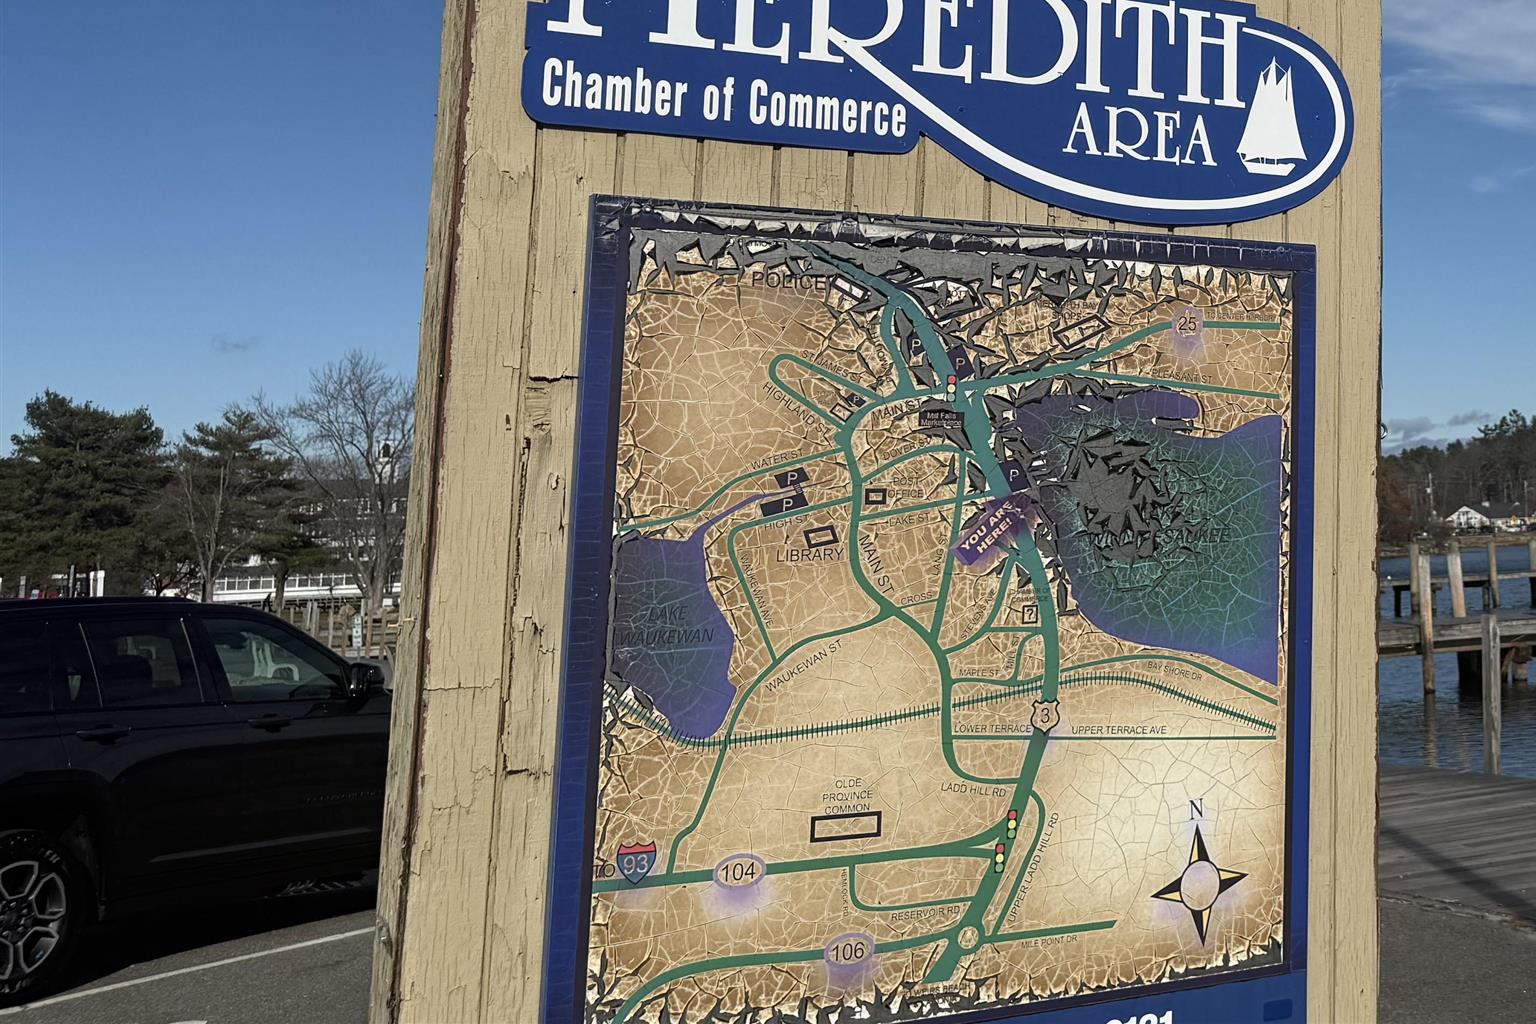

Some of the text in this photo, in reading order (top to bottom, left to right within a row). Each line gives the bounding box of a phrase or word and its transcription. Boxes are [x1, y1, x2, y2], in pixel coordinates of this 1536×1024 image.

[542, 56, 908, 139] Chamber of Commerce
[1062, 102, 1218, 168] AREA
[752, 271, 827, 291] POLICE
[1178, 316, 1197, 331] 25
[912, 339, 921, 351] P
[818, 356, 849, 378] JAMES
[956, 358, 965, 370] P
[1152, 368, 1212, 384] PLEASANT ST
[762, 382, 832, 437] HIGHLAND ST
[871, 397, 922, 422] MAIN ST
[750, 448, 804, 470] WATER ST
[883, 442, 916, 461] DOVER
[787, 472, 798, 485] P
[893, 477, 919, 485] POST
[1009, 469, 1019, 482] P
[888, 489, 924, 498] OFFICE
[782, 498, 793, 511] P
[764, 515, 809, 531] HIGH ST
[889, 512, 931, 526] LAKE ST
[960, 501, 1015, 551] YOU ARE
[976, 517, 1013, 554] HERE!
[776, 548, 844, 562] LIBRARY
[932, 533, 948, 576] LANG ST
[858, 534, 895, 594] MAIN ST
[740, 553, 774, 627] WAUKEWAN AVE
[900, 591, 933, 605] CROSS
[648, 605, 688, 621] LAKE
[960, 588, 996, 641] STEVENS AVE
[620, 628, 714, 645] WAUKEWAN
[765, 639, 842, 692] WAUKEWAN ST
[1005, 648, 1017, 672] MILL
[959, 668, 987, 676] MAPLE
[1147, 661, 1203, 681] BAY SHORE DR
[1040, 707, 1050, 723] 3
[954, 724, 1032, 734] LOWER TERRACE
[1071, 725, 1168, 735] UPPER TERRACE AVE
[835, 778, 862, 788] OLDE
[940, 782, 1007, 797] LADD HILL RD
[822, 790, 873, 802] PROVINCE
[825, 803, 870, 815] COMMON
[1189, 797, 1203, 820] N
[593, 854, 648, 878] TO 93
[721, 862, 756, 882] 104
[1008, 812, 1060, 923] UPPER LADD HILL RD
[841, 868, 849, 917] HEMLOCK RD
[947, 905, 961, 915] RD
[1021, 934, 1078, 949] MILE POINT DR
[832, 941, 865, 962] 106
